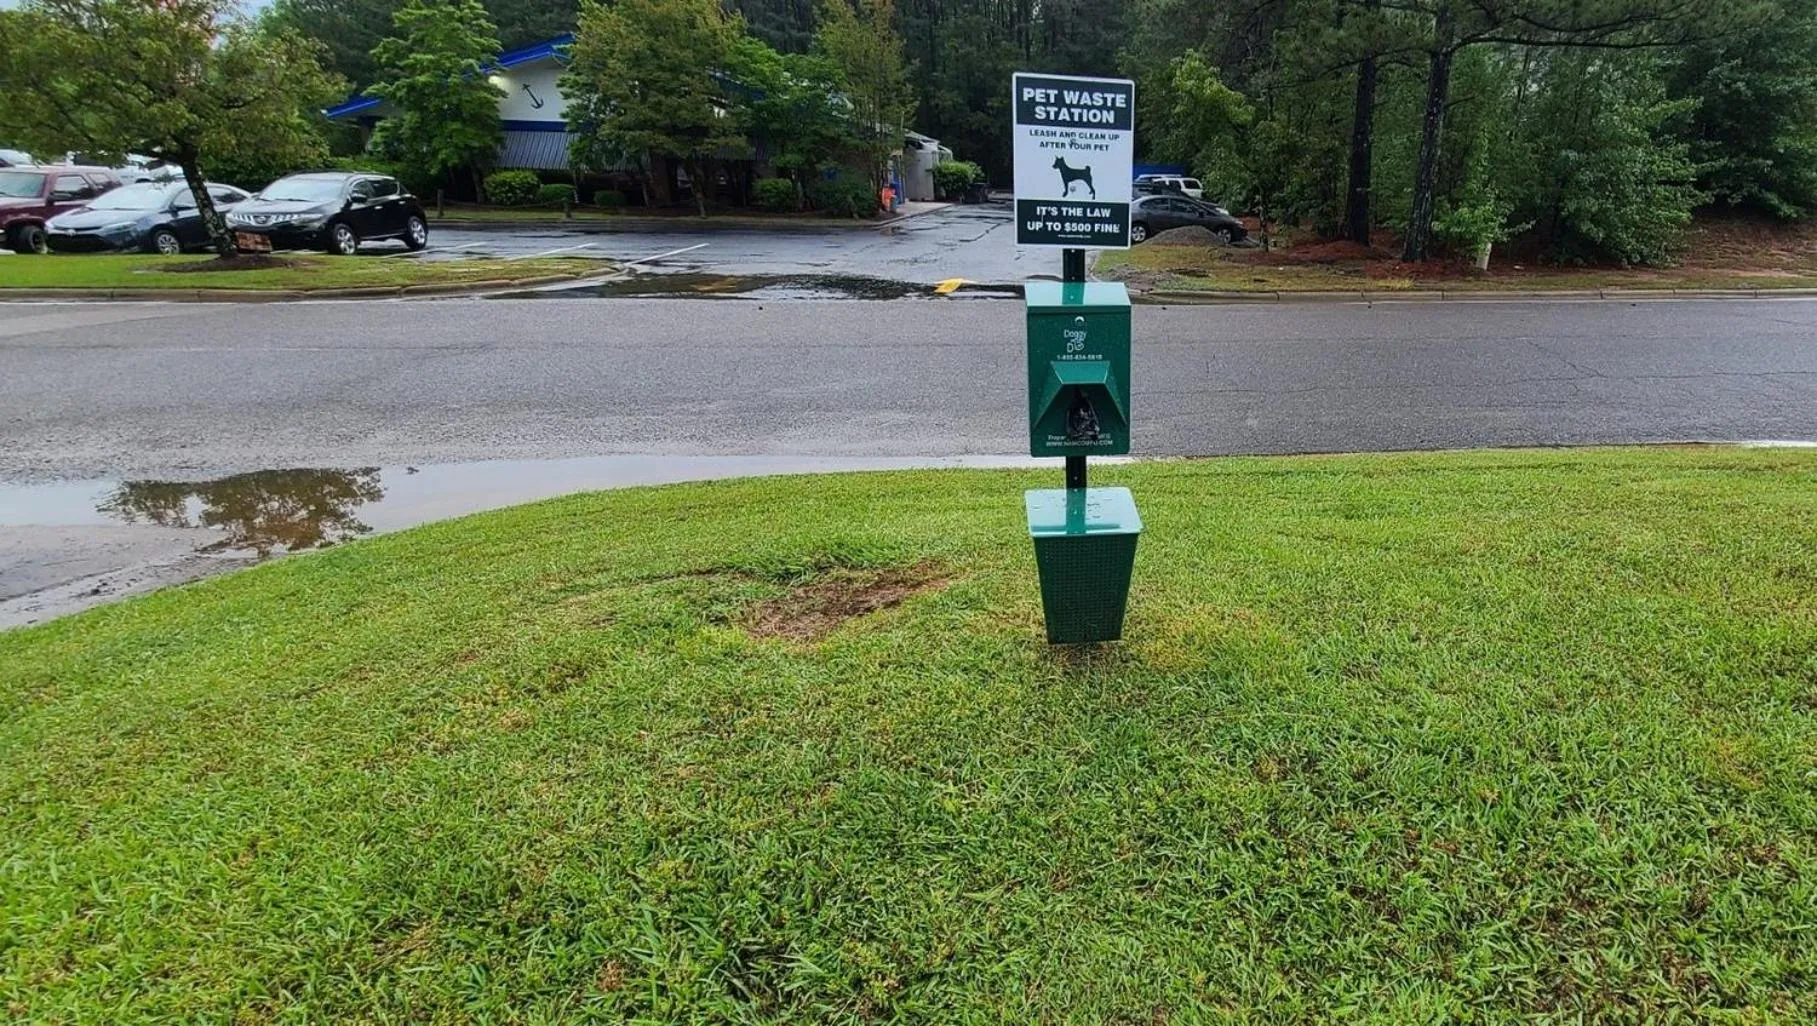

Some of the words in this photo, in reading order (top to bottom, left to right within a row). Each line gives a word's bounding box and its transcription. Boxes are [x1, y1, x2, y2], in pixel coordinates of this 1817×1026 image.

[1022, 87, 1058, 103] PET
[1063, 90, 1126, 107] WASTE
[1034, 105, 1115, 123] STATION
[1029, 129, 1057, 138] LEASH
[1079, 132, 1106, 140] CLEAN
[1039, 141, 1066, 149] AFTER
[1068, 142, 1092, 151] YOUR
[1094, 144, 1110, 152] PET
[1036, 206, 1058, 216] IT'S
[1061, 207, 1083, 217] THE
[1086, 208, 1111, 218] LAW
[1026, 221, 1043, 231] UP
[1046, 222, 1061, 231] TO
[1064, 222, 1091, 233] $500
[1094, 223, 1120, 234] FINE
